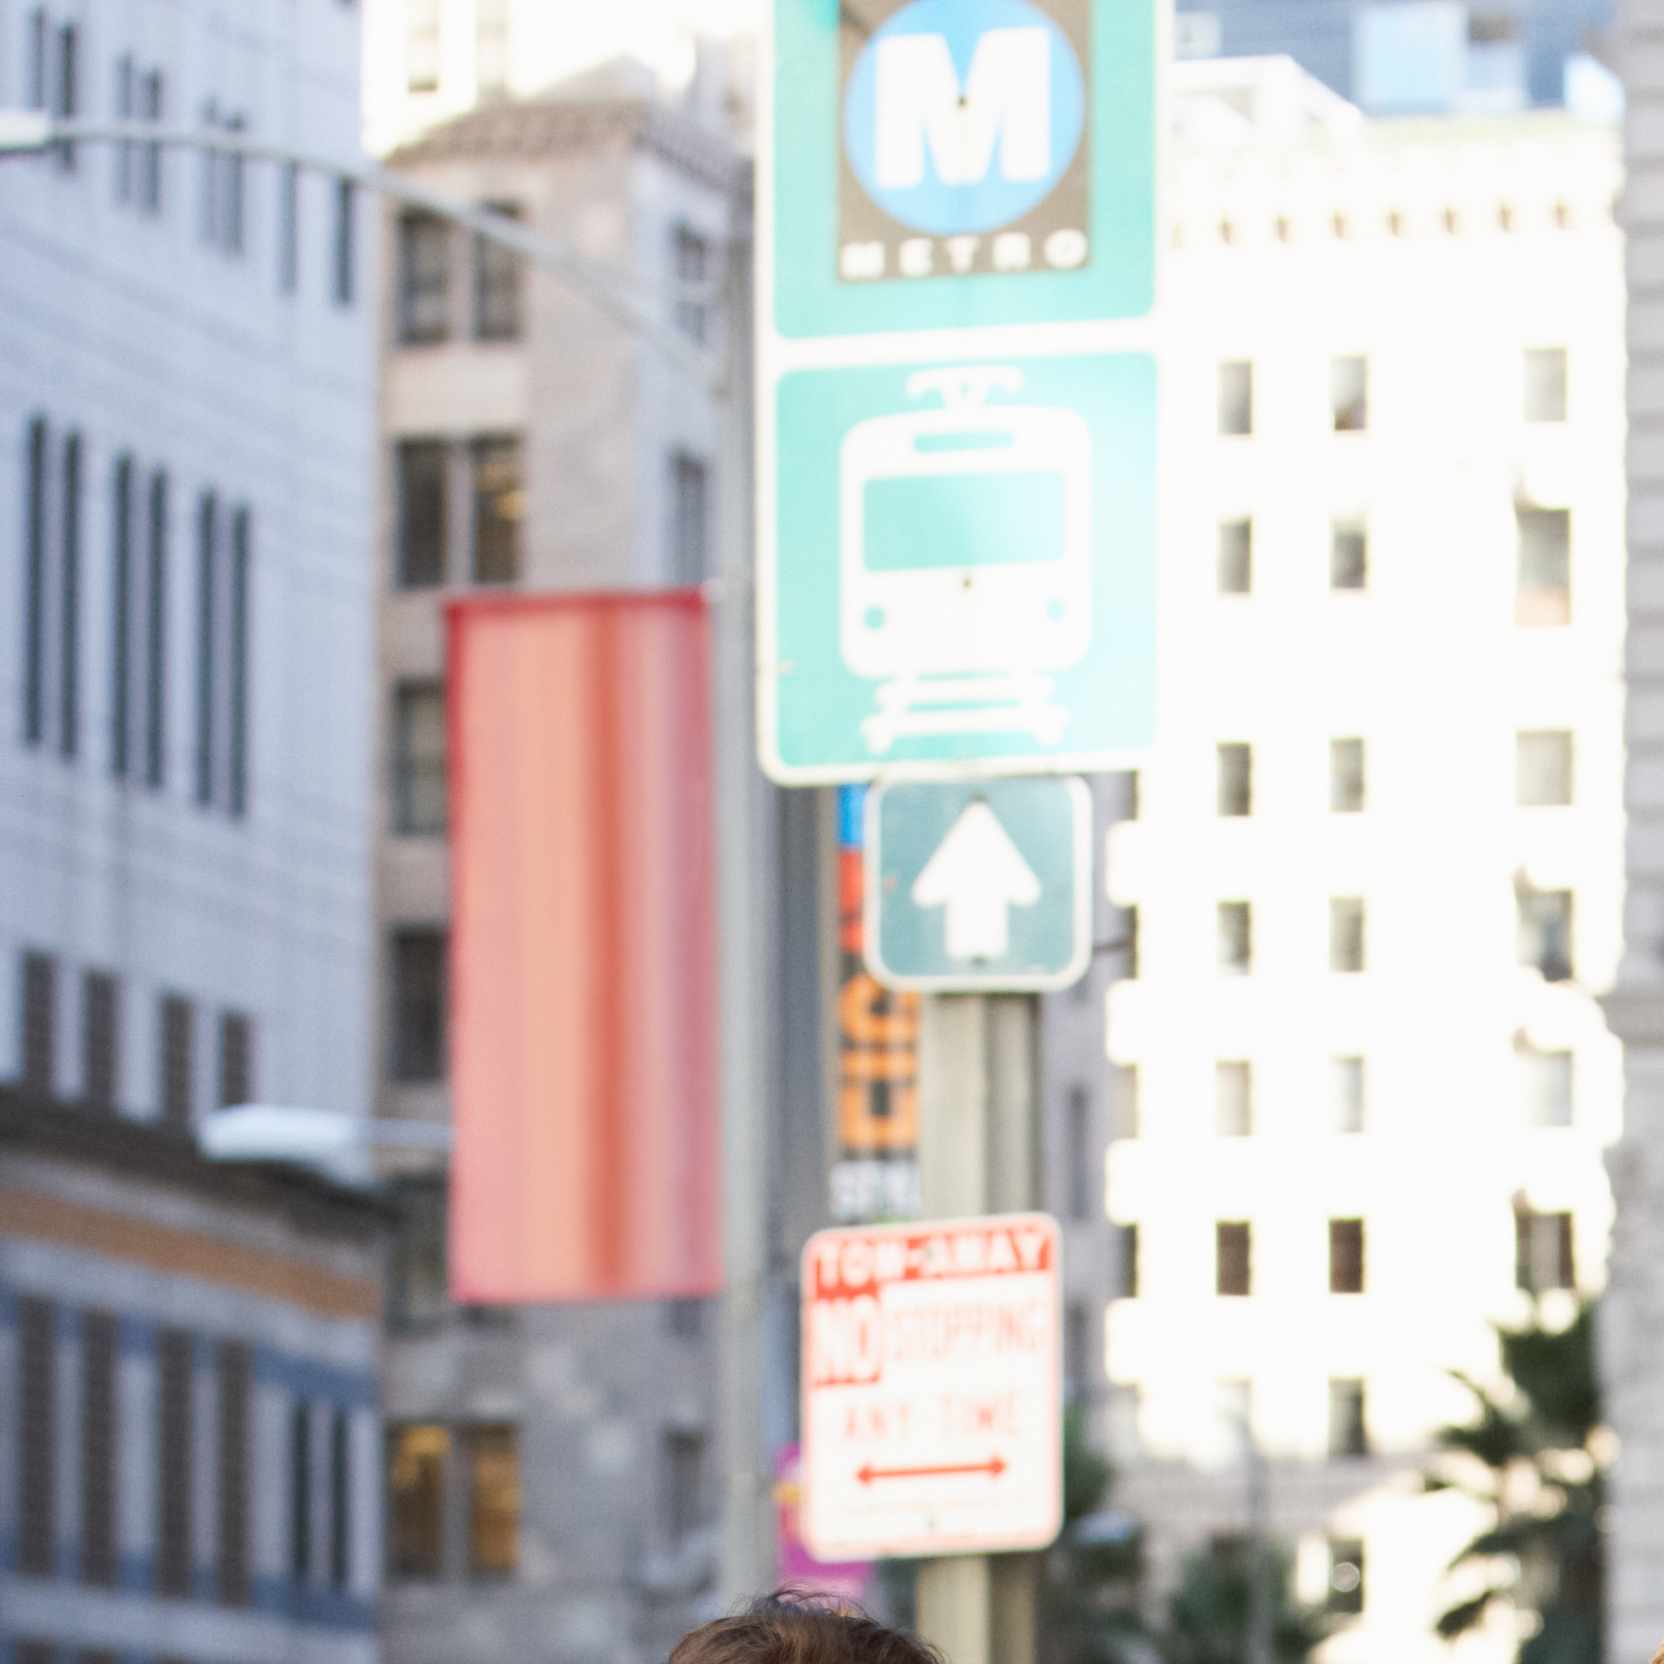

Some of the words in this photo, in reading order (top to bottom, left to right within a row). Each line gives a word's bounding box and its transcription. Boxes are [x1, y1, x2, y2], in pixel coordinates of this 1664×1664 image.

[876, 27, 1051, 187] M
[841, 228, 1087, 279] METRO
[815, 1229, 1049, 1288] TOW-AWAY
[813, 1296, 879, 1382] NO
[843, 1400, 912, 1439] ANY
